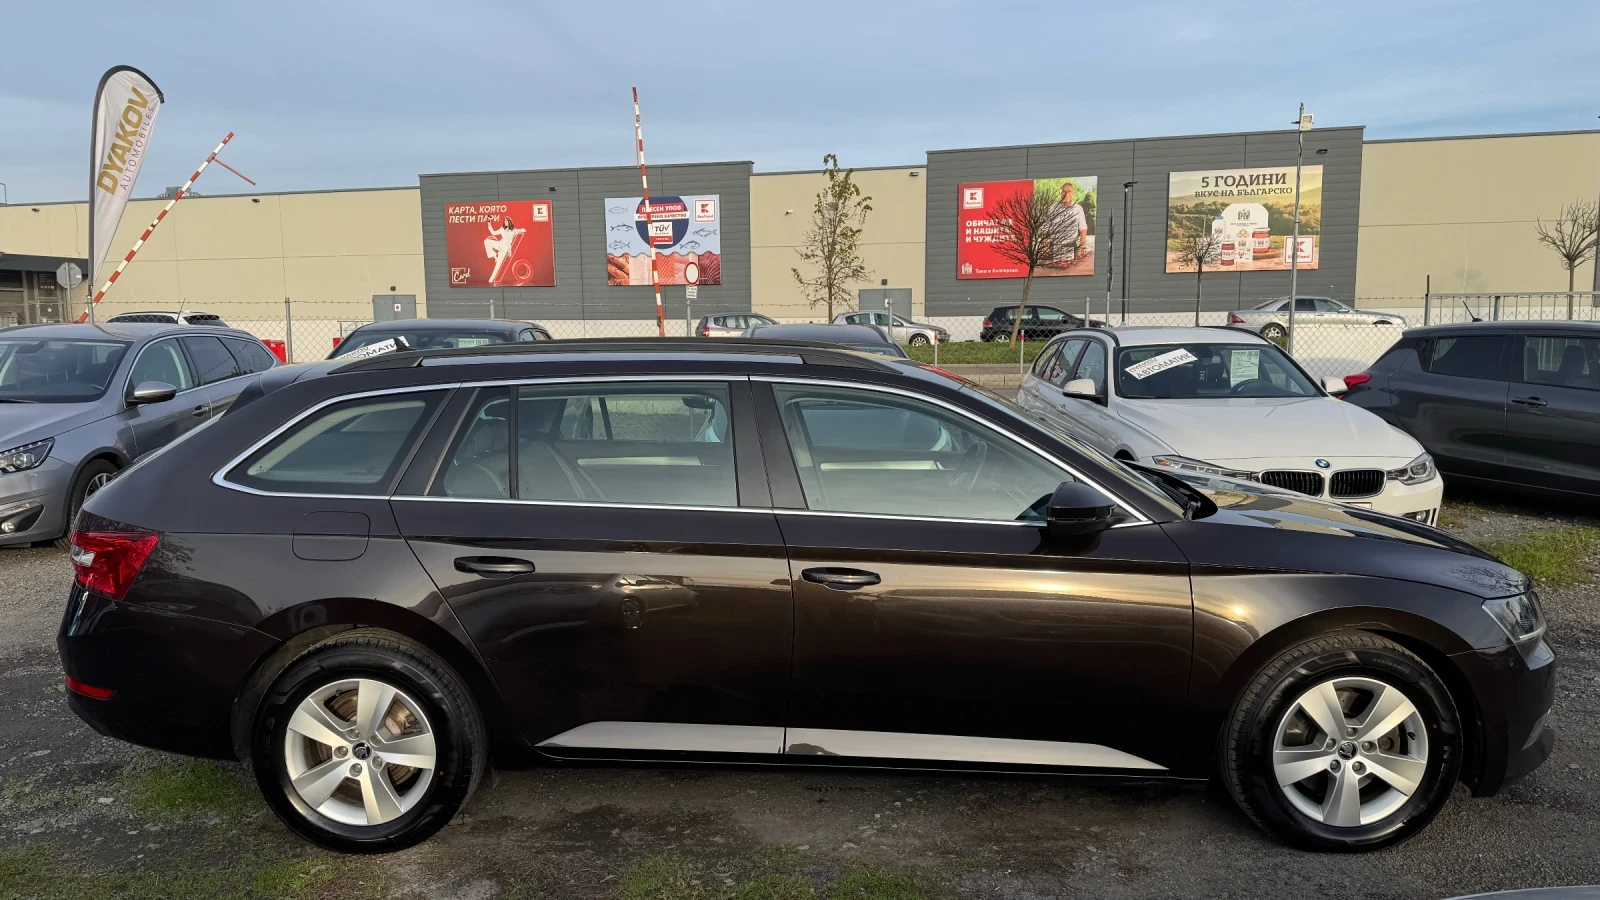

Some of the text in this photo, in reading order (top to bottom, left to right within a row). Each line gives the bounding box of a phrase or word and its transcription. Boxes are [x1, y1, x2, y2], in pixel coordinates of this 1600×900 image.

[97, 86, 148, 195] DYAKOV
[120, 106, 154, 190] AUTOMOBILES
[1201, 173, 1287, 188] 5 ГОДИНИ
[1236, 187, 1293, 196] БЪЛГАРСКО
[449, 205, 507, 215] КАРТА, КОЯТО
[449, 215, 476, 223] ПЕСТИ
[655, 224, 671, 232] TÜV
[1136, 352, 1193, 379] АВТОМАТИК
